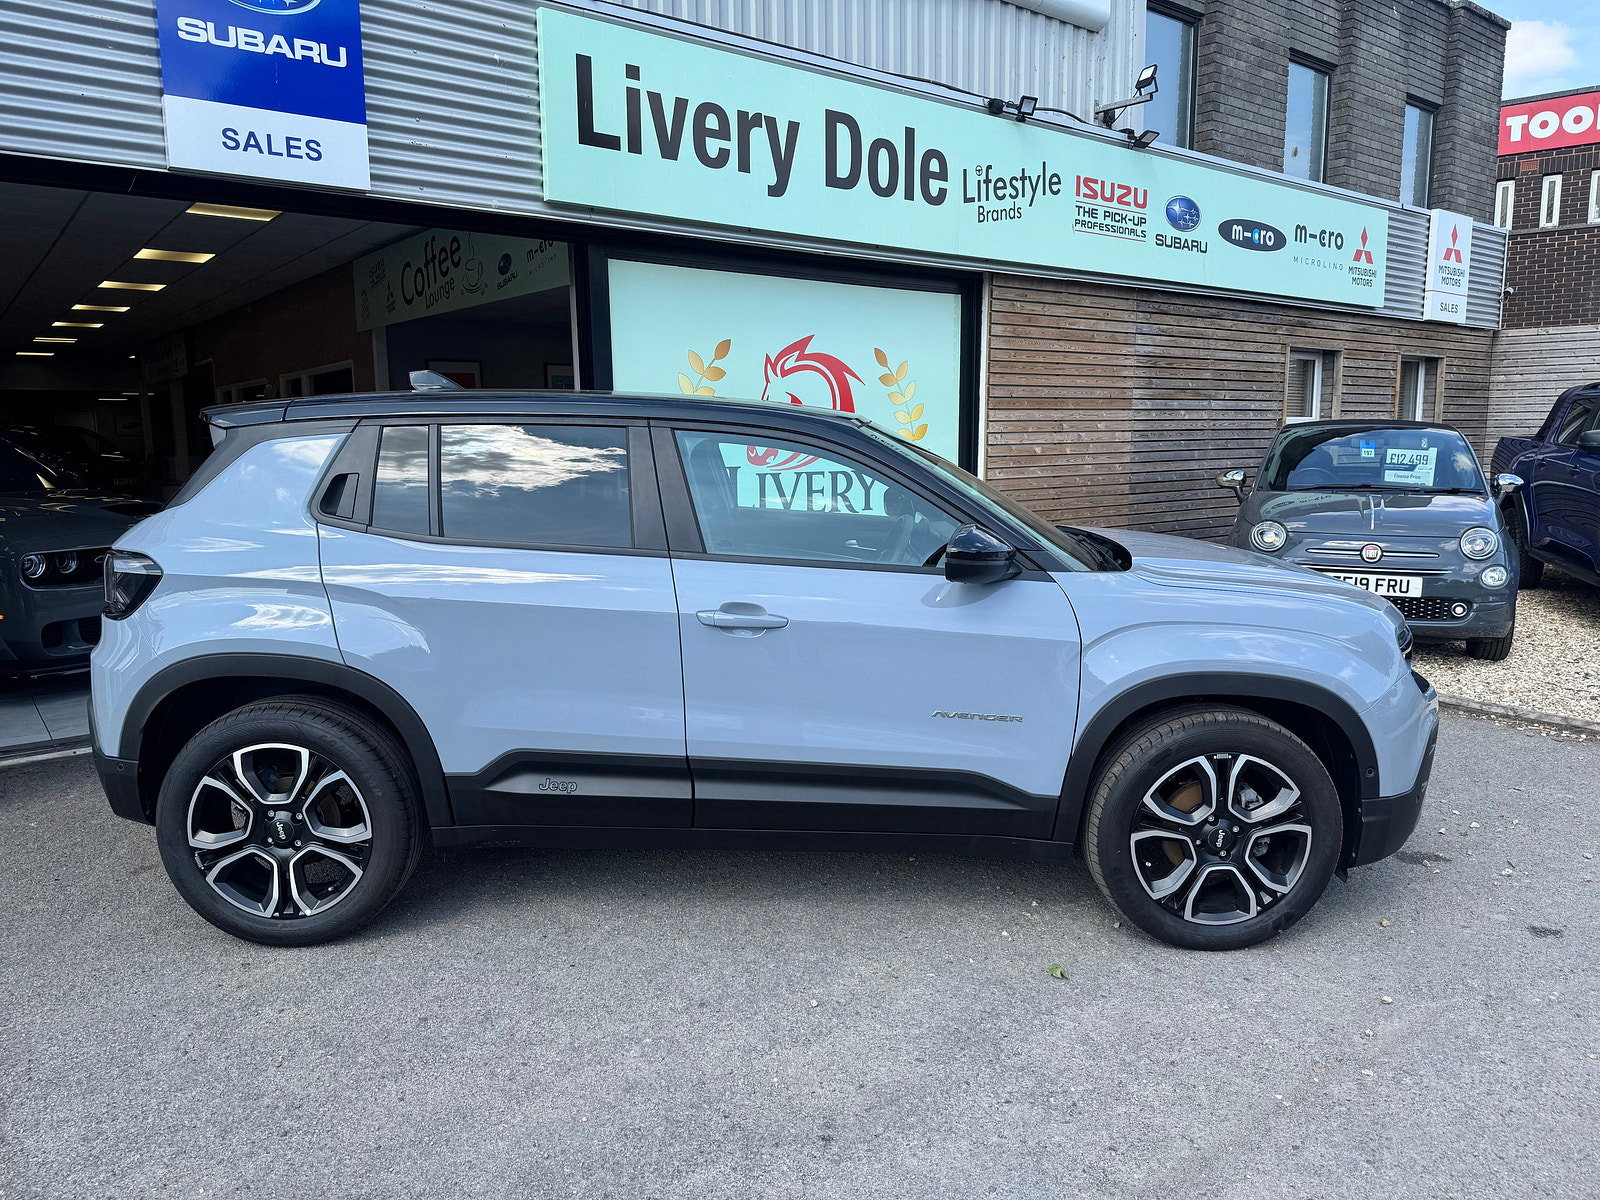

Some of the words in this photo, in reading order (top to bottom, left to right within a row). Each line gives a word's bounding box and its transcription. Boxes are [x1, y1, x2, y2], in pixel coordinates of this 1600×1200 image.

[177, 16, 348, 69] SUBARU
[575, 53, 801, 198] Livery
[825, 108, 949, 206] Dole
[1505, 103, 1600, 143] TOO
[221, 127, 323, 162] SALES
[962, 161, 1062, 207] Lifestyle
[1075, 175, 1148, 209] ISUZU
[977, 201, 1022, 223] Brands
[1075, 205, 1099, 219] THE
[1103, 210, 1147, 227] PICK-UP
[1074, 219, 1147, 238] PROFESSIONALS
[1155, 233, 1208, 254] SUBARU
[401, 235, 461, 305] Coffee
[1293, 255, 1344, 271] MICROLINO
[1348, 265, 1377, 278] MITSUBISHI
[1438, 264, 1466, 278] MITSUBISHI
[497, 270, 518, 291] SUBARU
[1351, 276, 1373, 288] MOTORS
[1440, 276, 1462, 288] MOTORS
[424, 277, 455, 310] Lounge
[1439, 301, 1459, 314] SALES
[1375, 578, 1410, 594] FRU
[931, 710, 1024, 723] AVENGER
[539, 777, 578, 794] Jeep
[276, 821, 287, 840] Jeep
[1215, 829, 1226, 848] Jeep
